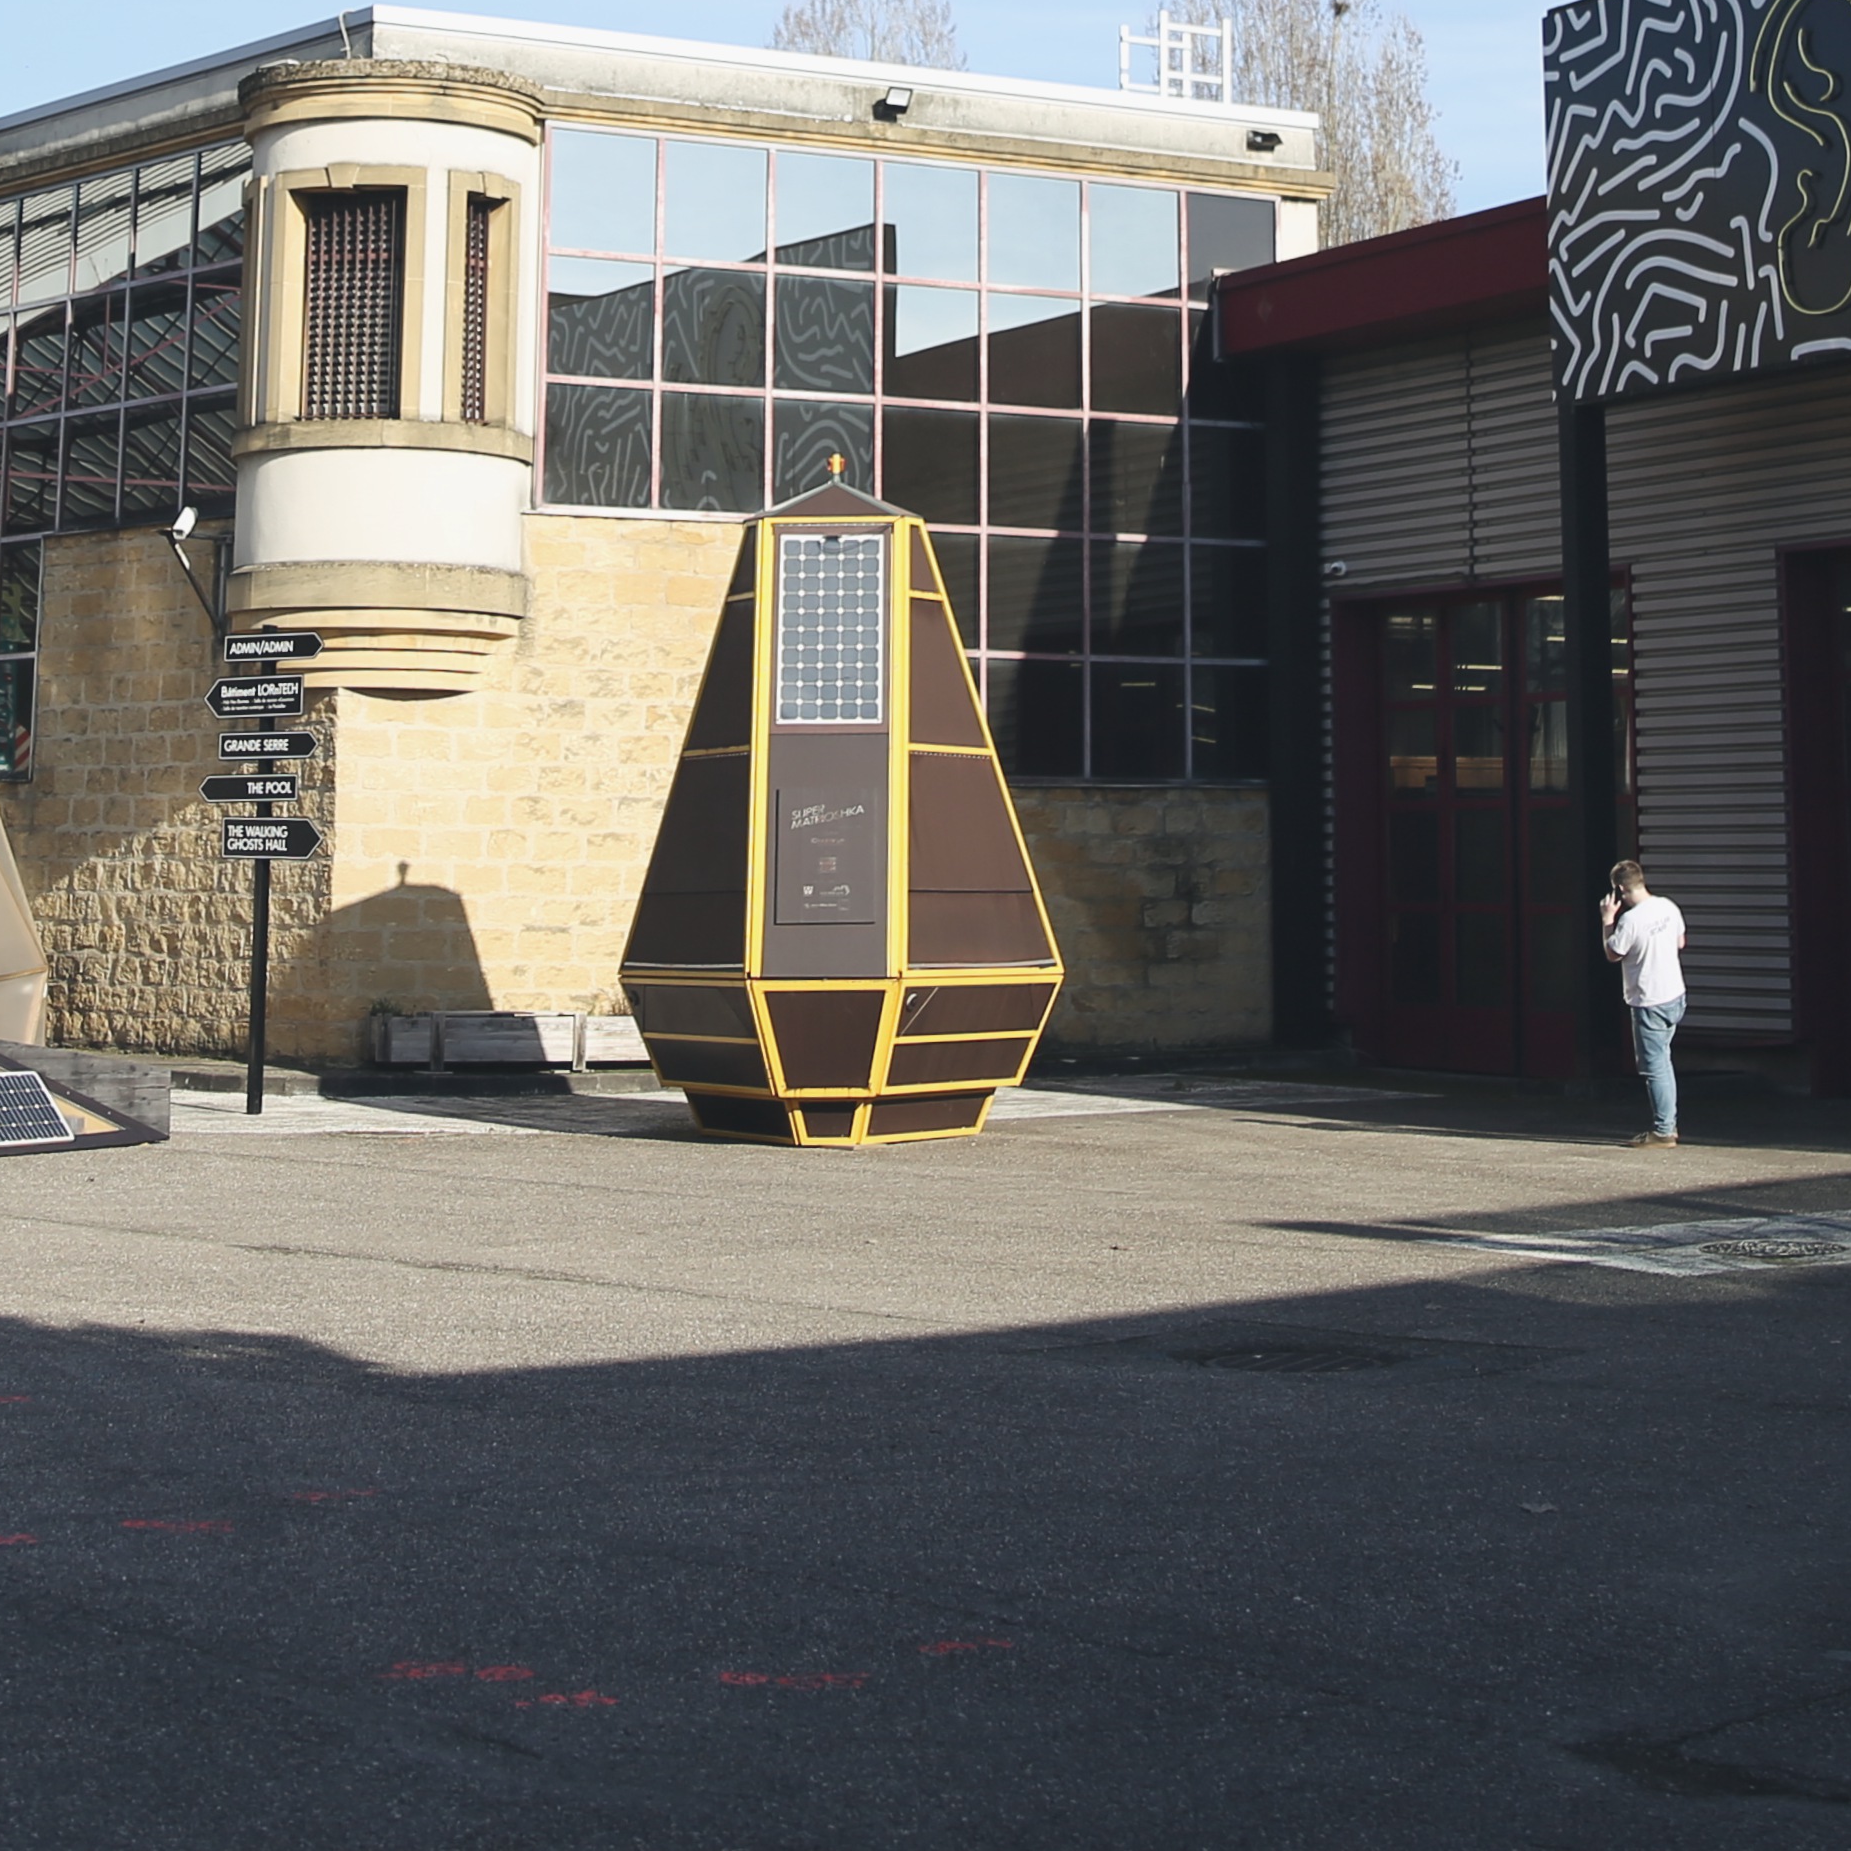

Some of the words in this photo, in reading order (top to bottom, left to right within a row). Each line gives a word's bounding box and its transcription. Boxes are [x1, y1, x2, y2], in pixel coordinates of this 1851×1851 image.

[229, 640, 294, 655] ADMIN/ADMIN
[223, 739, 261, 752] GRANDE
[263, 738, 289, 751] SERRE
[247, 782, 264, 794] THE
[265, 781, 292, 794] POOL
[227, 825, 244, 837] THE
[245, 825, 288, 838] WALKING
[227, 838, 264, 851] GHOSTS
[265, 839, 288, 851] HALL
